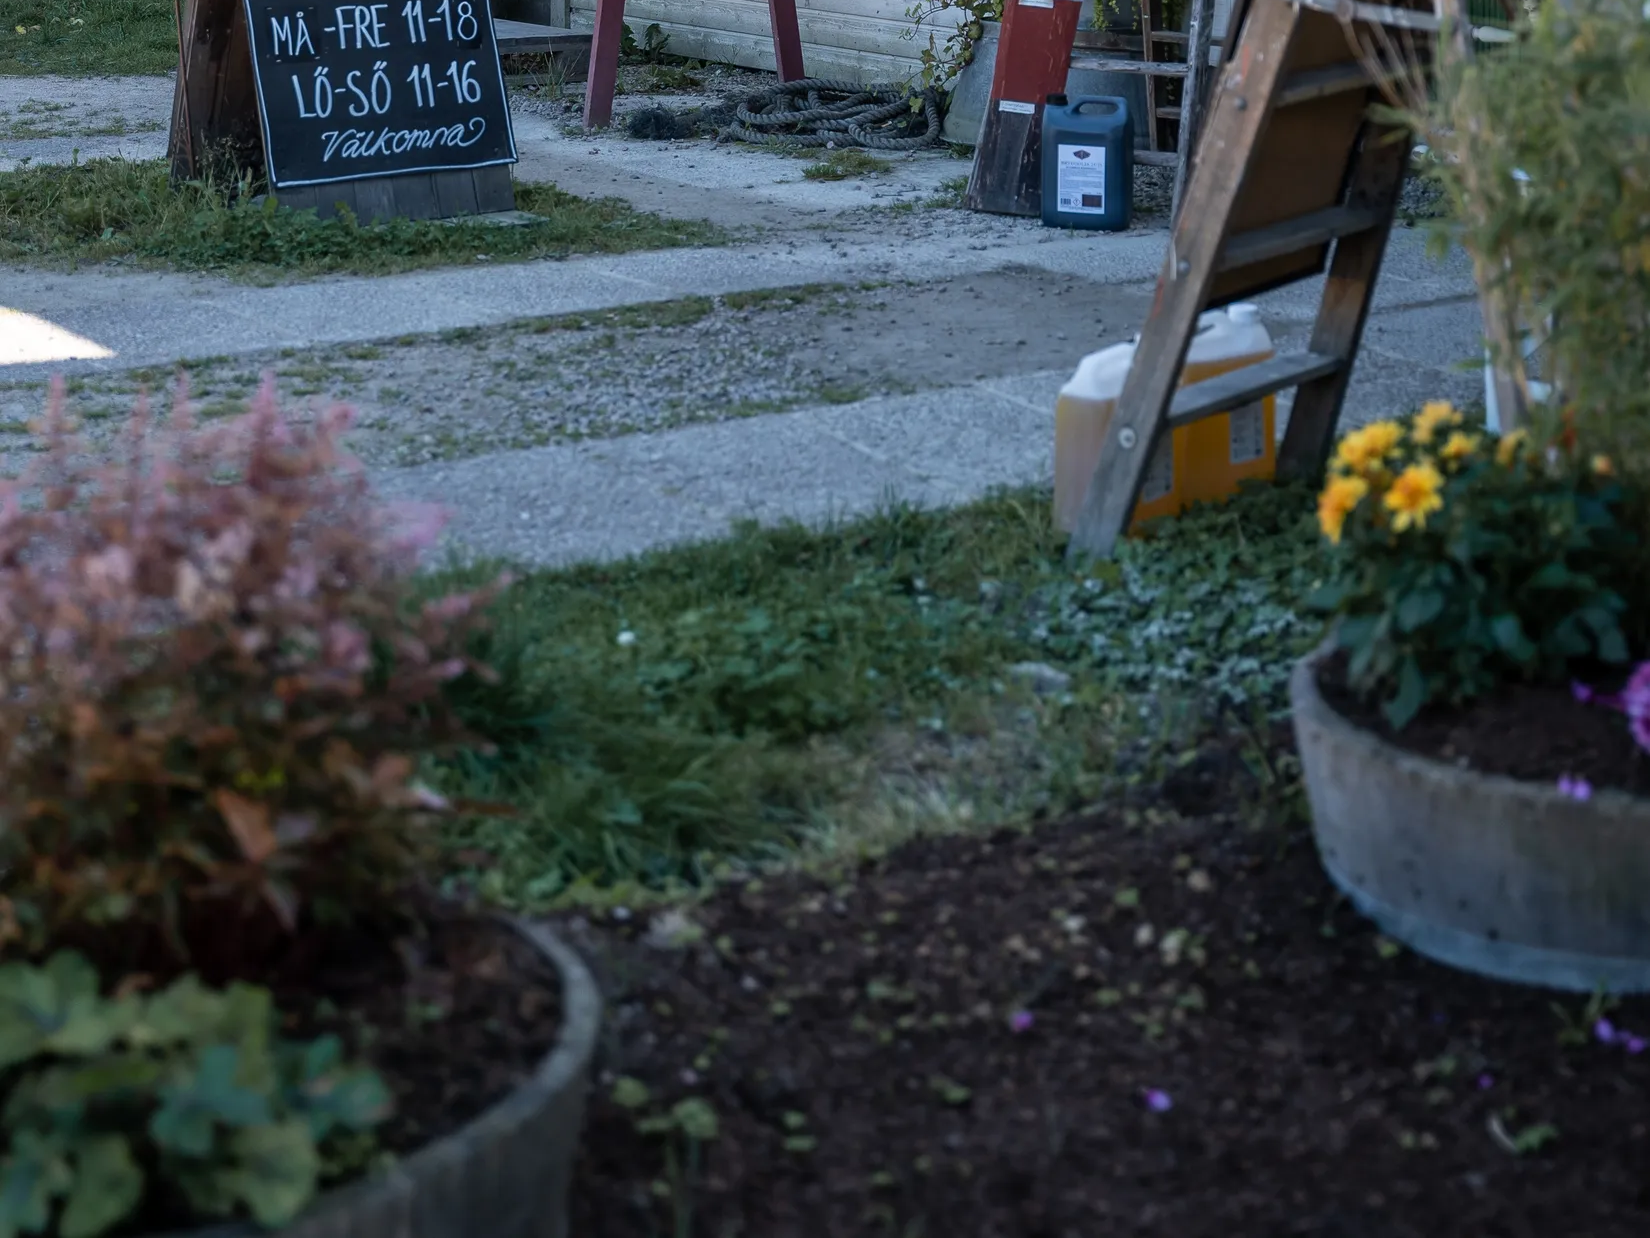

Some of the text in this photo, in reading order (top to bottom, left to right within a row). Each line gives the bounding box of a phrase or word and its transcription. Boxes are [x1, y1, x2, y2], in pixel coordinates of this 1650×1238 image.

[271, 11, 317, 58] MÅ
[291, 60, 482, 119] LÖ-SÖ 11-16
[321, 117, 486, 163] Välkomna
